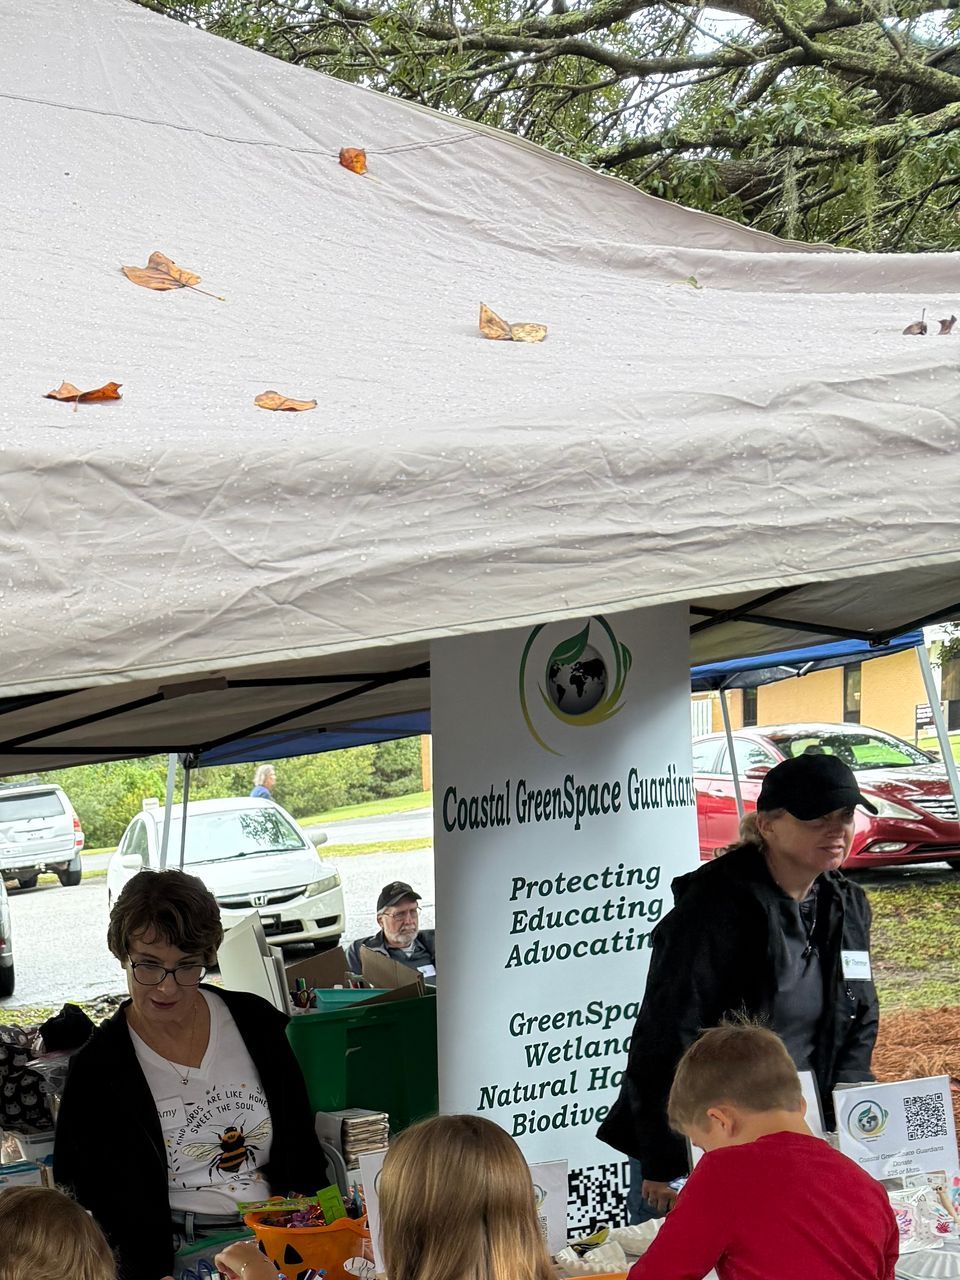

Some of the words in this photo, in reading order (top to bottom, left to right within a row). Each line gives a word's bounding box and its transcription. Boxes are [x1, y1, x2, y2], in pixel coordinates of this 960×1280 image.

[442, 779, 511, 832] Coastal
[515, 774, 622, 831] GreenSpace
[509, 863, 661, 901] Protecting
[509, 896, 664, 935] Educating
[509, 1000, 640, 1037] GreenSpa
[477, 1071, 578, 1111] Natural
[175, 1128, 186, 1146] KIND
[185, 1105, 204, 1127] ORDS
[207, 1092, 221, 1105] ARE
[225, 1090, 243, 1099] LIKE
[190, 1110, 214, 1134] SWEET
[216, 1103, 232, 1114] THE
[235, 1102, 255, 1111] SOUL
[511, 1102, 609, 1138] Biodive
[892, 1159, 913, 1167] Donate
